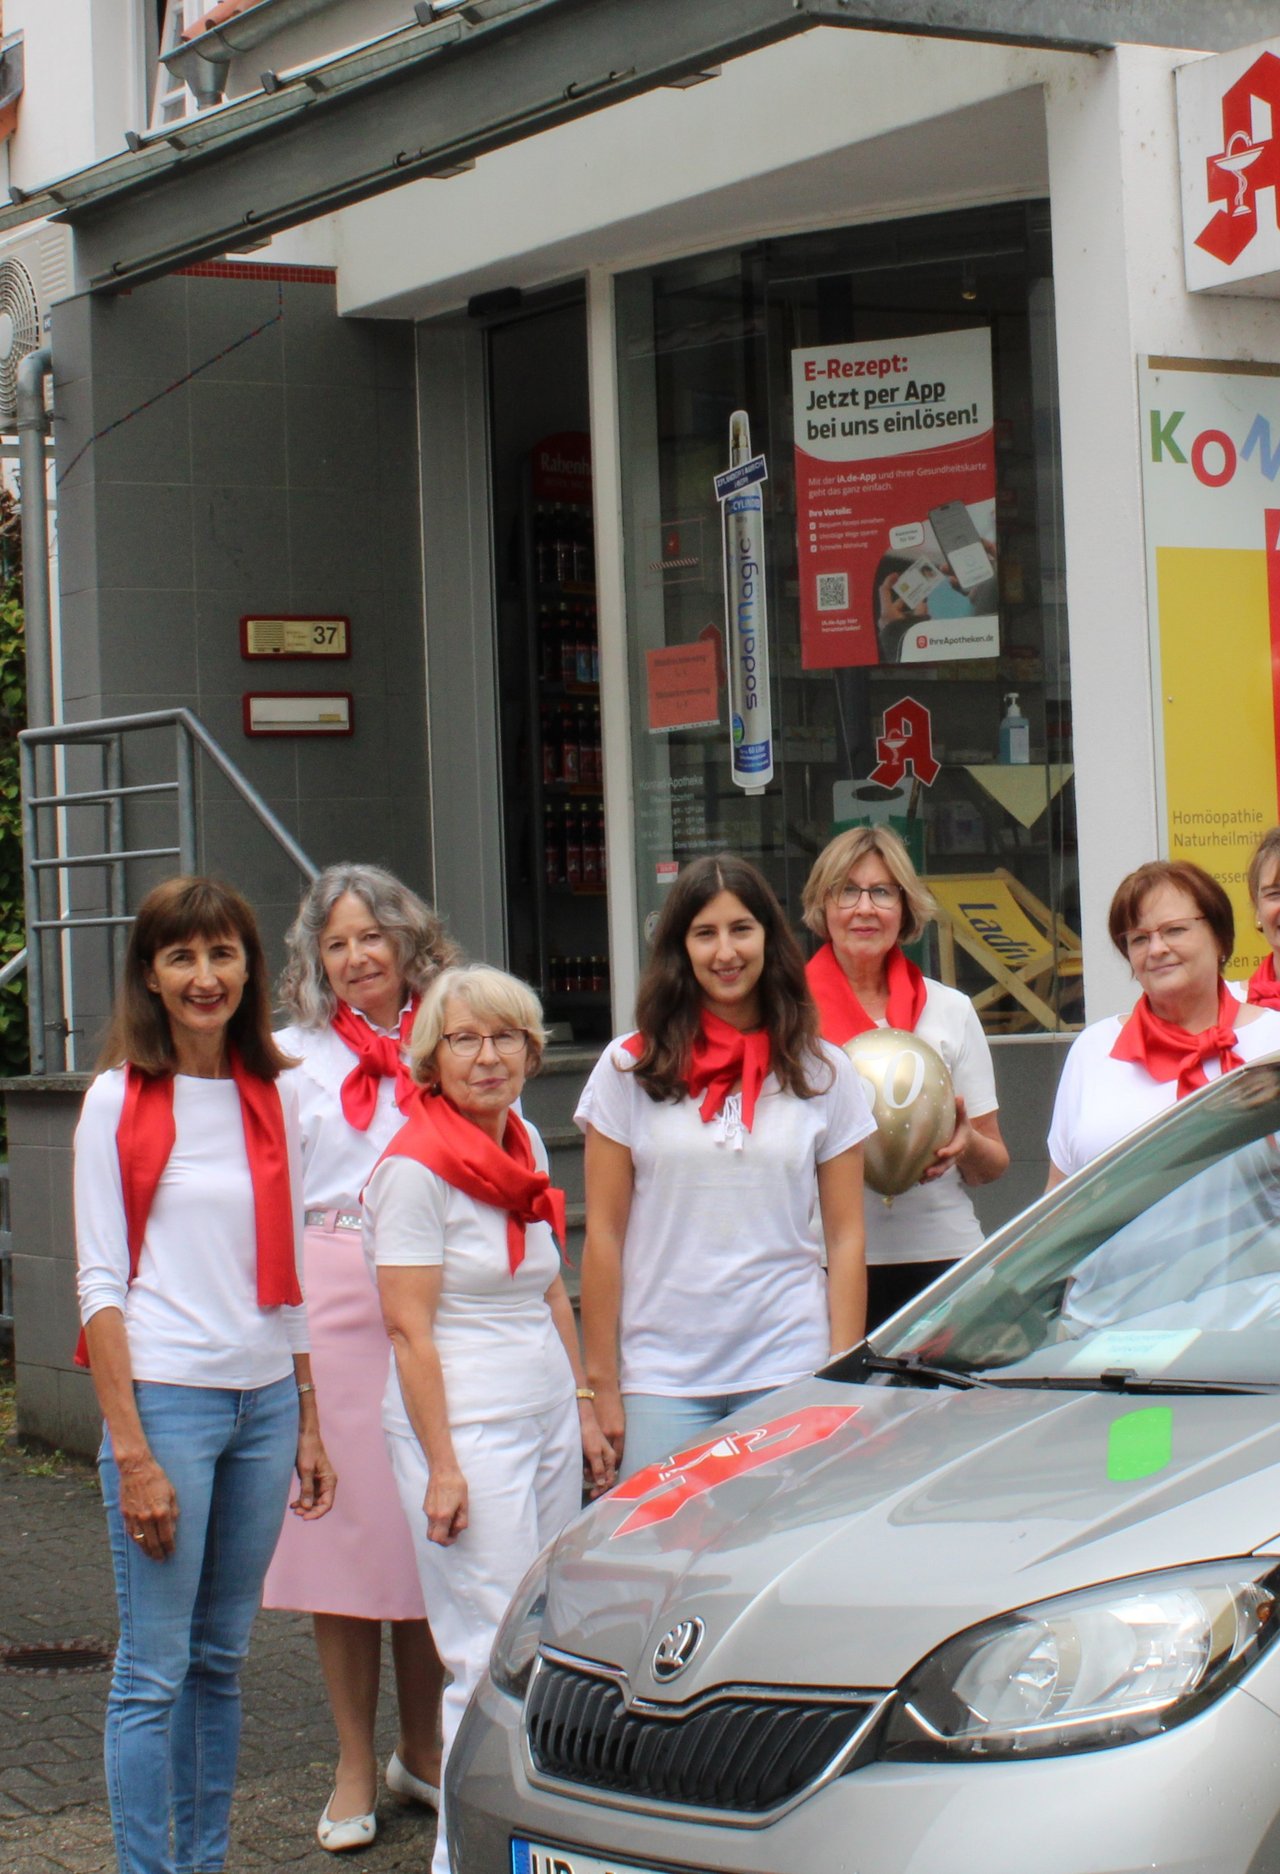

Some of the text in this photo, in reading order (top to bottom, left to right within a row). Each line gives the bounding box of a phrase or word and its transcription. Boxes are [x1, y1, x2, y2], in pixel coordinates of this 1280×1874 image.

[804, 355, 908, 381] E-Rezept:
[806, 380, 945, 411] Jetzt per App
[807, 403, 978, 440] bei uns einlösen!
[541, 451, 591, 476] Rabenh
[822, 476, 836, 485] der
[878, 470, 894, 479] und
[916, 462, 987, 477] Gesundheitskarte
[828, 486, 841, 496] das
[842, 485, 860, 496] ganz
[313, 625, 338, 645] 37
[1172, 808, 1264, 828] Homöopathie
[1173, 831, 1263, 847] Naturheilmitt
[958, 903, 1037, 969] Ladiv
